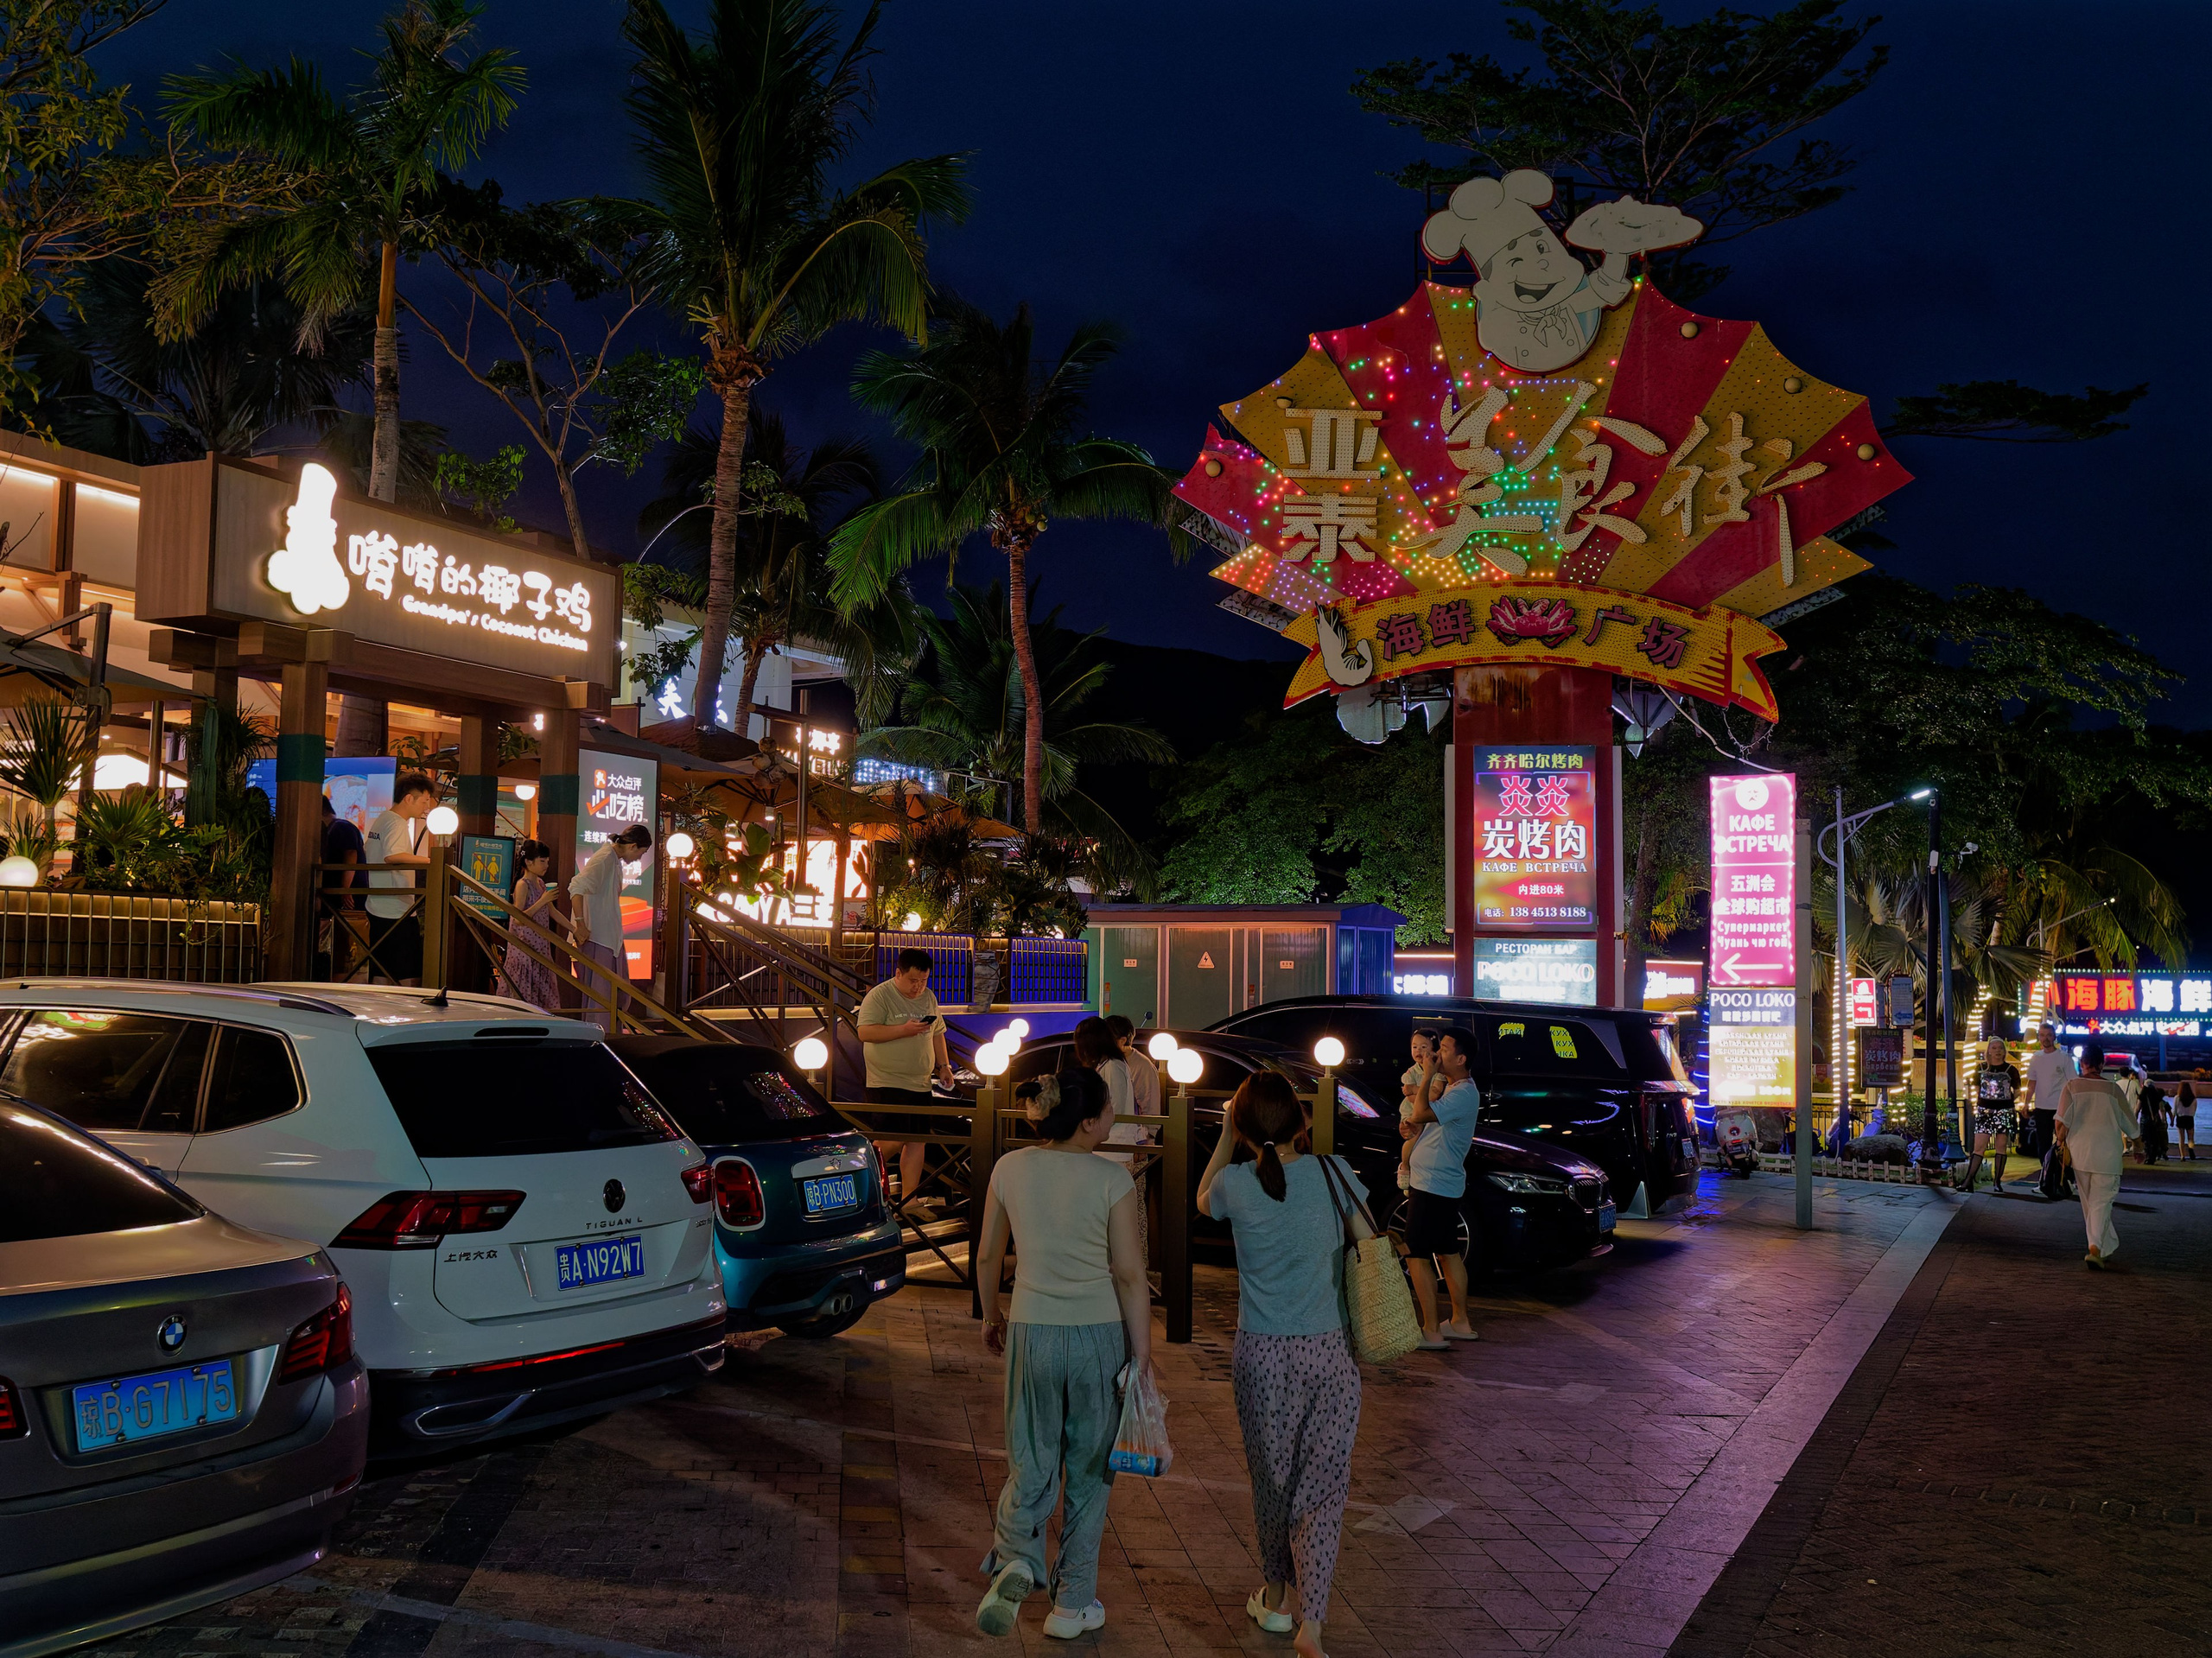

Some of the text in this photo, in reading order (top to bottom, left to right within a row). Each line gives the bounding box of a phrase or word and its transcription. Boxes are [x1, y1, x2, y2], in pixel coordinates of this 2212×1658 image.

[1281, 409, 1382, 562] 亚泰
[1388, 380, 1827, 588] 美食街
[1374, 599, 1692, 670] 海鲜 广场
[1486, 753, 1584, 770] 齐齐哈尔烤肉
[607, 774, 642, 791] 大众点评
[586, 789, 645, 823] 必吃榜
[1729, 814, 1776, 832] КАФЕ
[1481, 818, 1587, 860] 炭烤肉
[1482, 862, 1587, 873] КАФЕ ВСТРЕЧА
[1518, 884, 1565, 896] 内进80米
[1731, 873, 1776, 892] 五洲会
[1510, 907, 1529, 917] 138
[1531, 907, 1558, 917] 4513
[1560, 907, 1586, 917] 8188
[1715, 897, 1790, 915] 全球购超市
[1717, 921, 1789, 934] Супермаркет
[1496, 943, 1553, 954] РЕСТОРАН
[1477, 961, 1595, 983] POCO LOKO
[1711, 993, 1796, 1007] POCO LOKO
[2099, 1020, 2153, 1035] 大众点评
[586, 1218, 632, 1229] TIGUAN
[444, 1250, 499, 1262] 上汽大众
